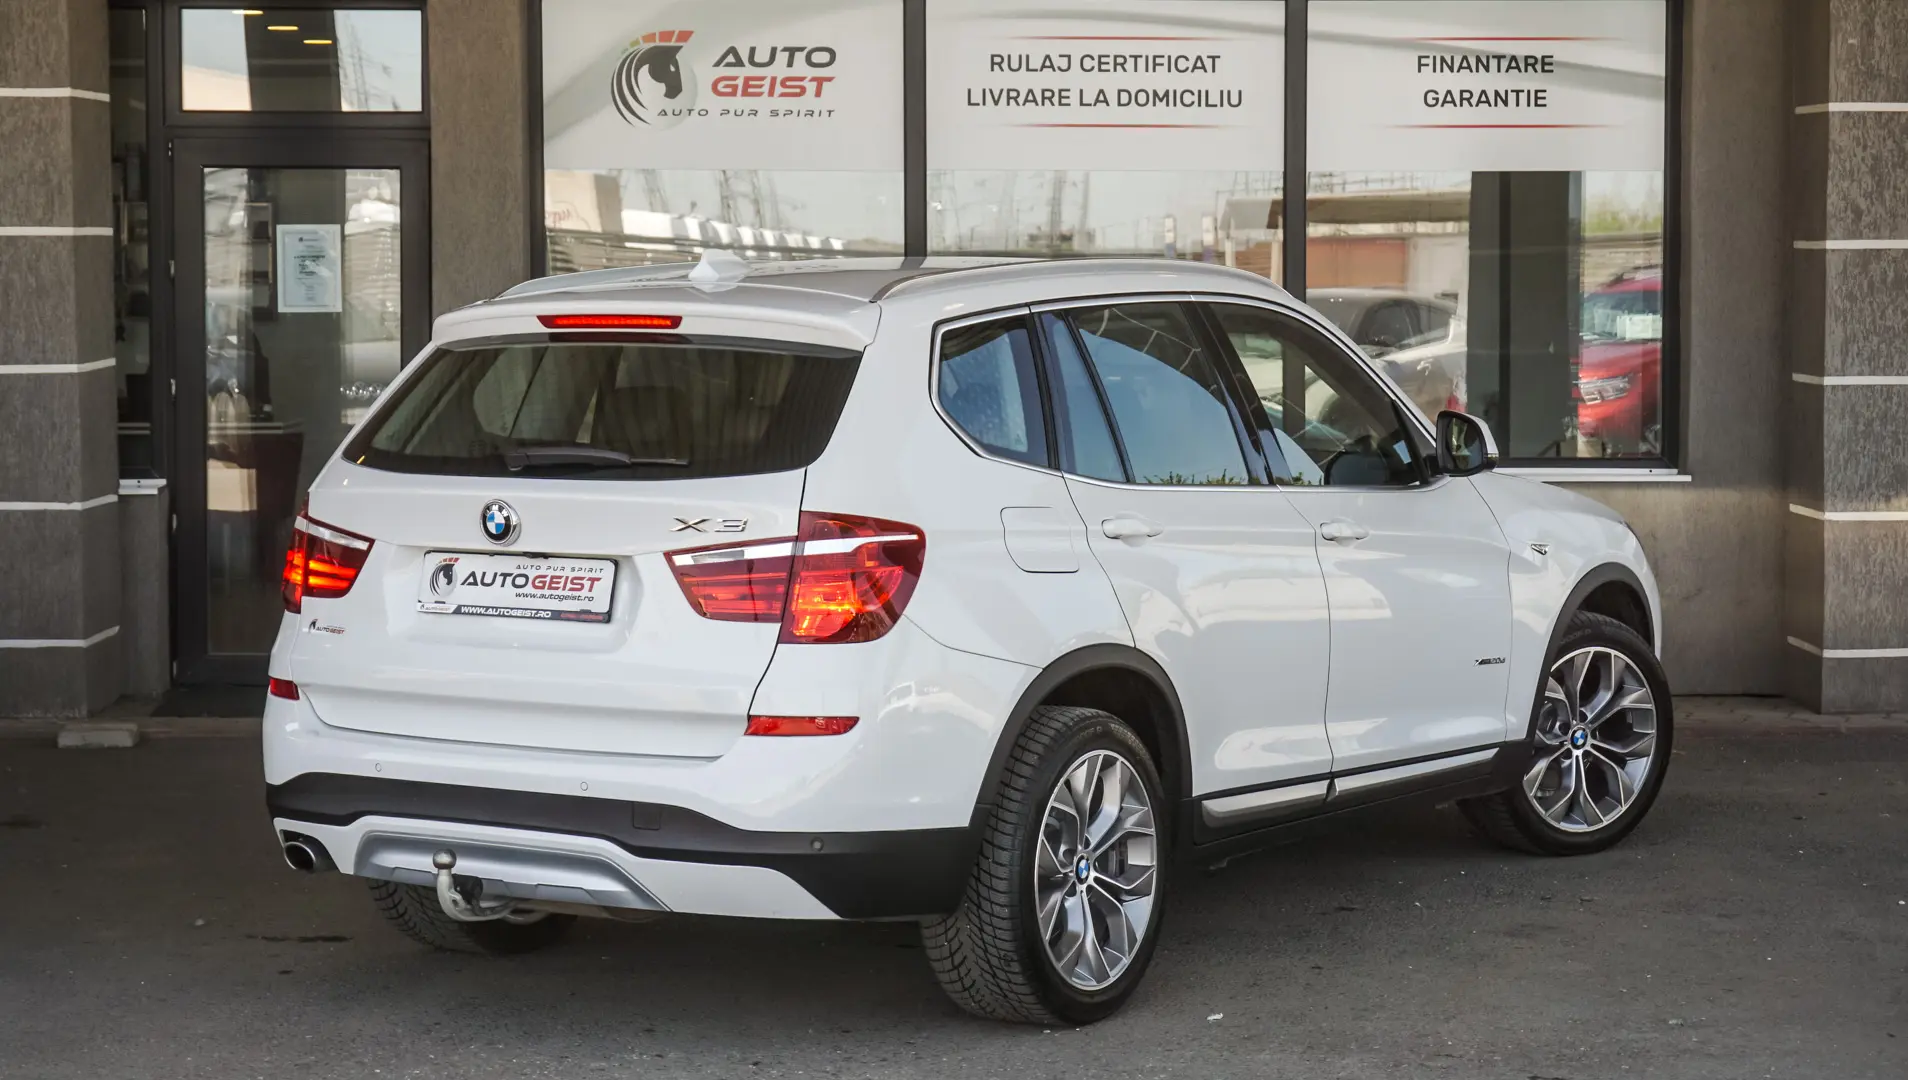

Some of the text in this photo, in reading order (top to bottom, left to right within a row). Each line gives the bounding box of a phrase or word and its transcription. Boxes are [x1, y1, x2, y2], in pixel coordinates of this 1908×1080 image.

[712, 45, 837, 68] AUTO
[990, 54, 1221, 73] RULAJ CERTIFICAT
[1417, 55, 1555, 73] FINANTARE
[711, 75, 837, 98] GEIST
[967, 88, 1243, 108] LIVRARE LA DOMICILIU
[1423, 89, 1548, 108] GARANTIE
[657, 108, 836, 118] AUTO PUR SPIRIT
[668, 517, 748, 533] X3
[570, 566, 604, 574] SPIRIT
[515, 592, 595, 602] www.autogeist.ro
[461, 605, 552, 619] WWW.AUTOGEIST.RO
